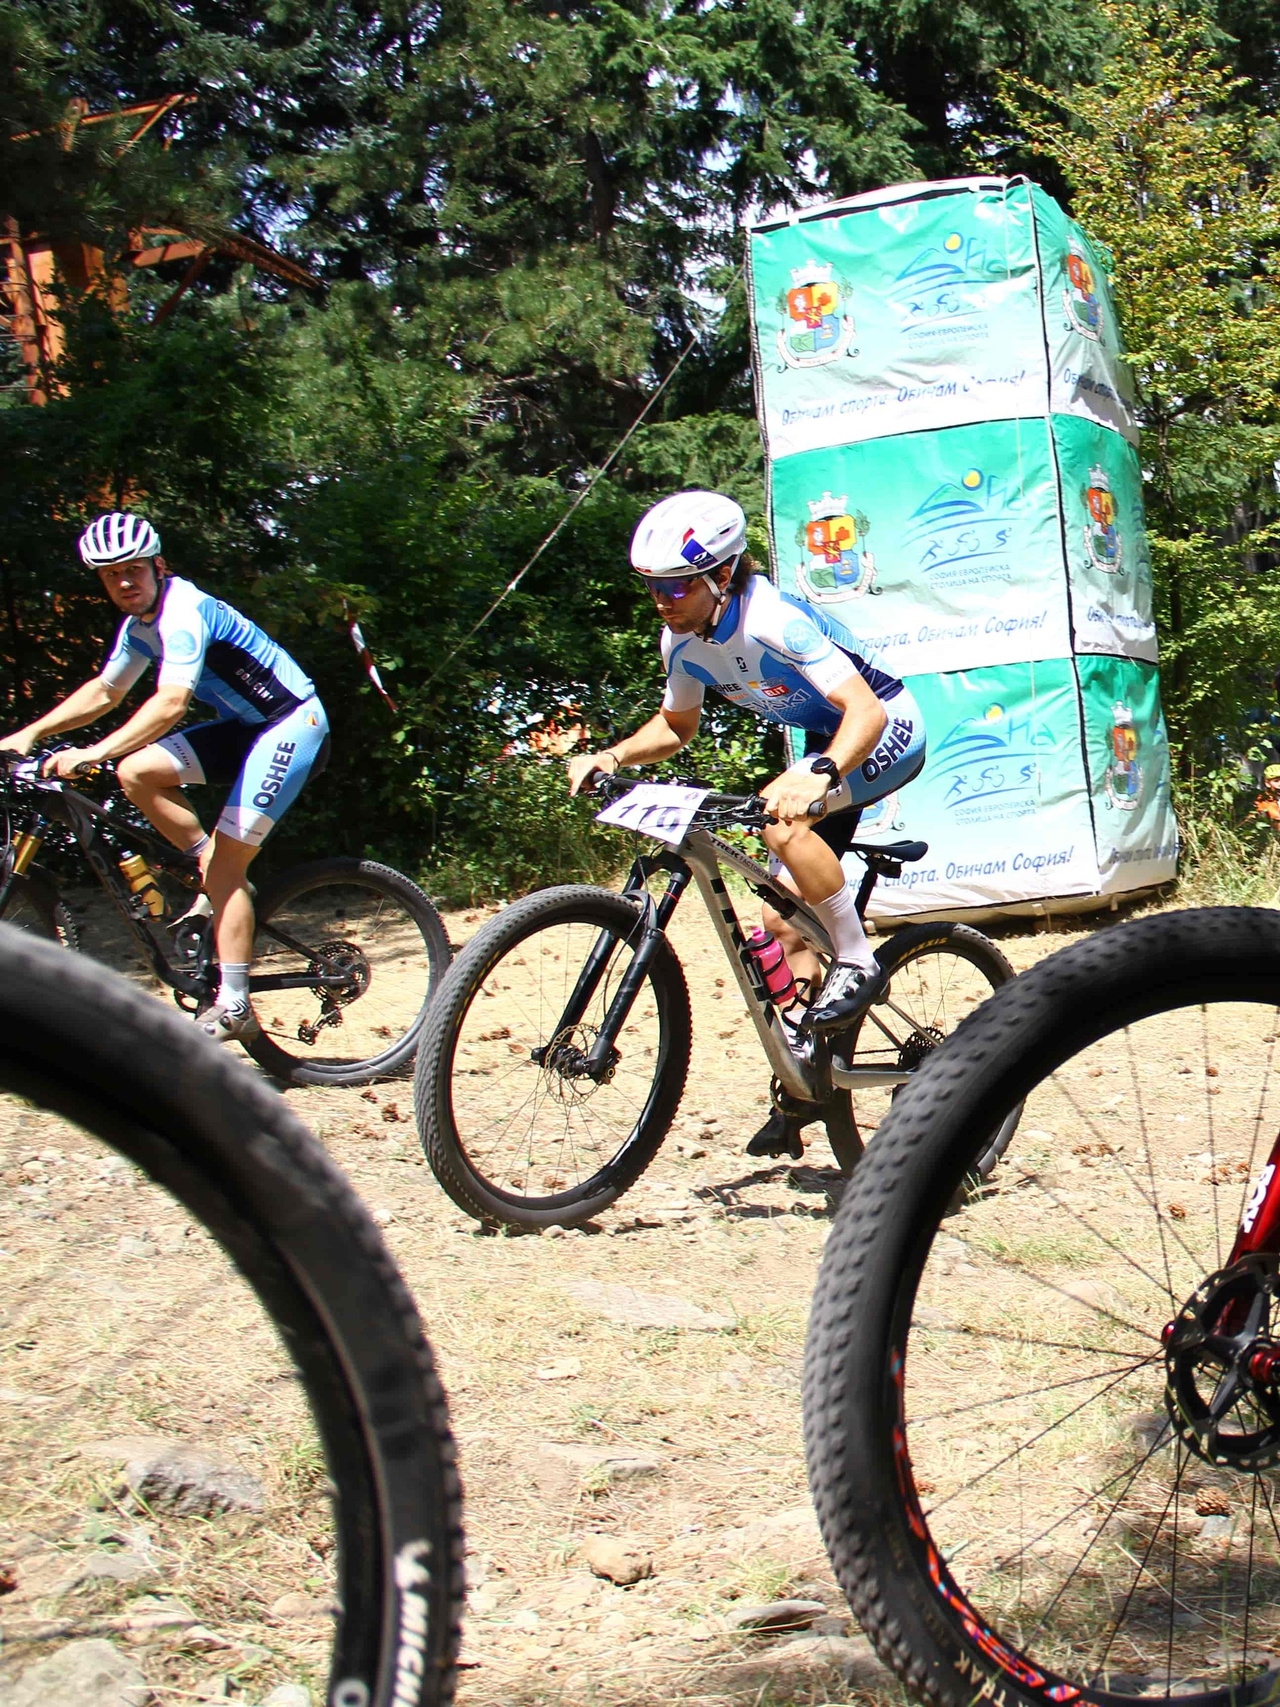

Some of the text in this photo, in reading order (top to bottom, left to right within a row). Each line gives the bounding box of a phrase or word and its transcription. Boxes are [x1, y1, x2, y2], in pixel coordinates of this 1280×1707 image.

[860, 610, 1049, 653] порта. Обичам София!
[235, 667, 275, 702] DOLCINI
[741, 688, 812, 712] EVSKI
[765, 686, 787, 697] ELIT
[861, 716, 914, 783] OSHEE
[253, 741, 296, 809] OSHEE
[711, 837, 740, 859] TREK
[946, 860, 1006, 880] Обичам
[1012, 846, 1075, 874] София!
[394, 1592, 429, 1707] MICH
[954, 1649, 1007, 1707] TRAK
